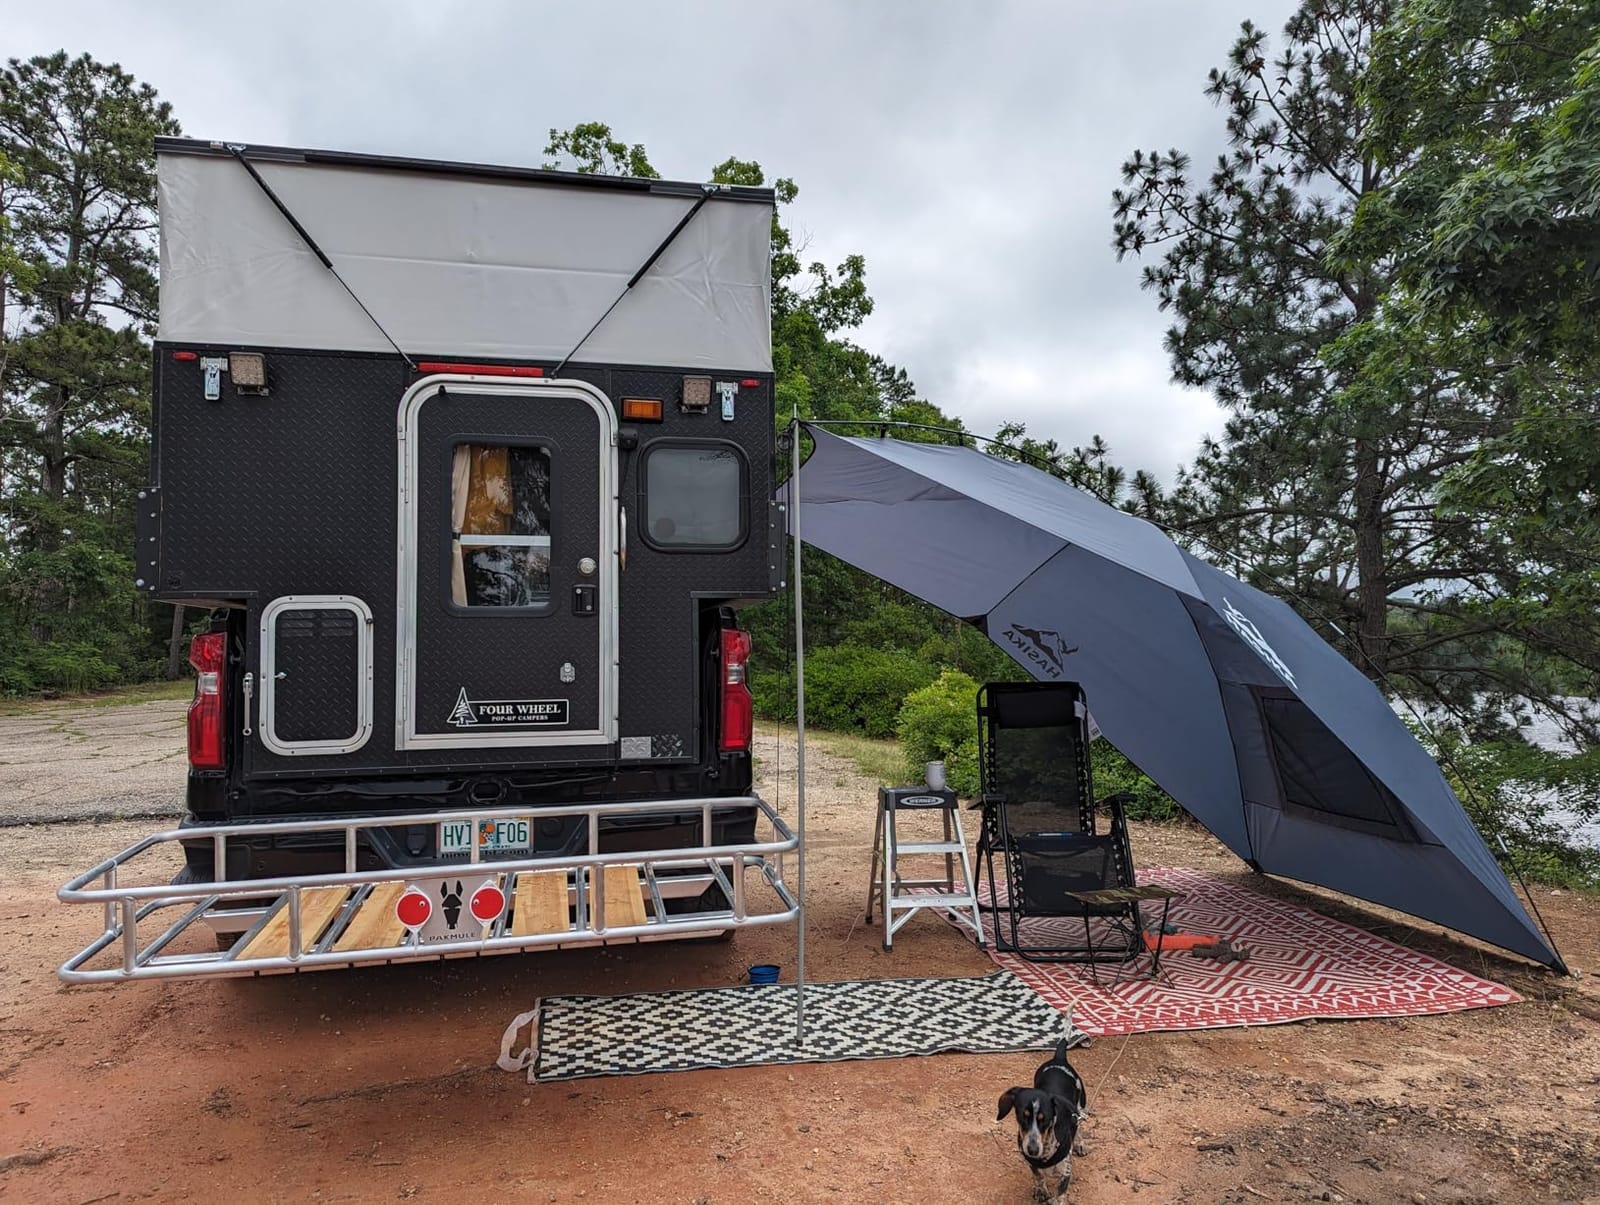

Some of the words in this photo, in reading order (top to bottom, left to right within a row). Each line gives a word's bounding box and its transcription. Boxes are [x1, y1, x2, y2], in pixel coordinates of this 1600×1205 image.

[479, 705, 514, 715] FOUR
[516, 704, 561, 714] WHEEL
[496, 821, 527, 844] F06
[429, 932, 476, 942] PAKMULE
